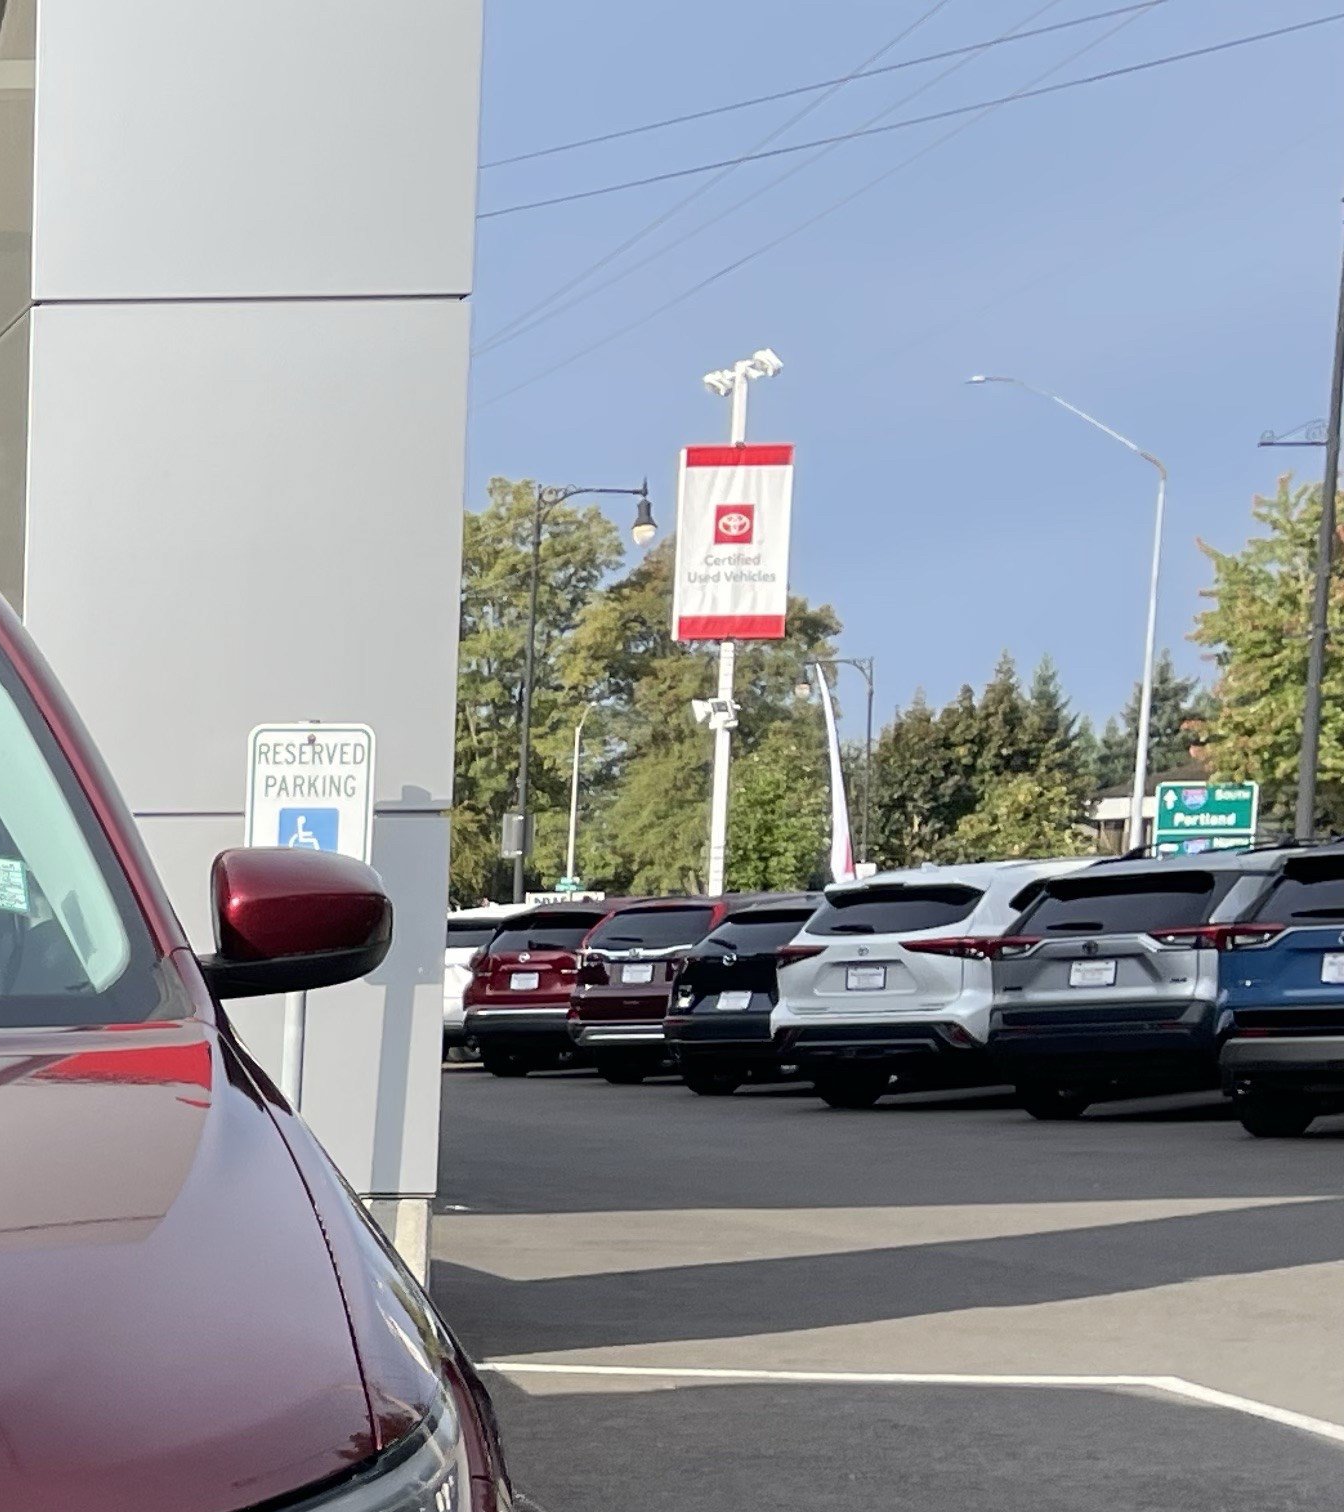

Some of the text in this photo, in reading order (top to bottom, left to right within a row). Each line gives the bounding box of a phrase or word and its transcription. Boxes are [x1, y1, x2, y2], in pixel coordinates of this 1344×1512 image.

[704, 553, 761, 567] Certified
[687, 570, 776, 584] Used Vehicles
[258, 743, 365, 765] RESERVED
[264, 775, 356, 798] PARKING
[1173, 812, 1236, 827] Portland
